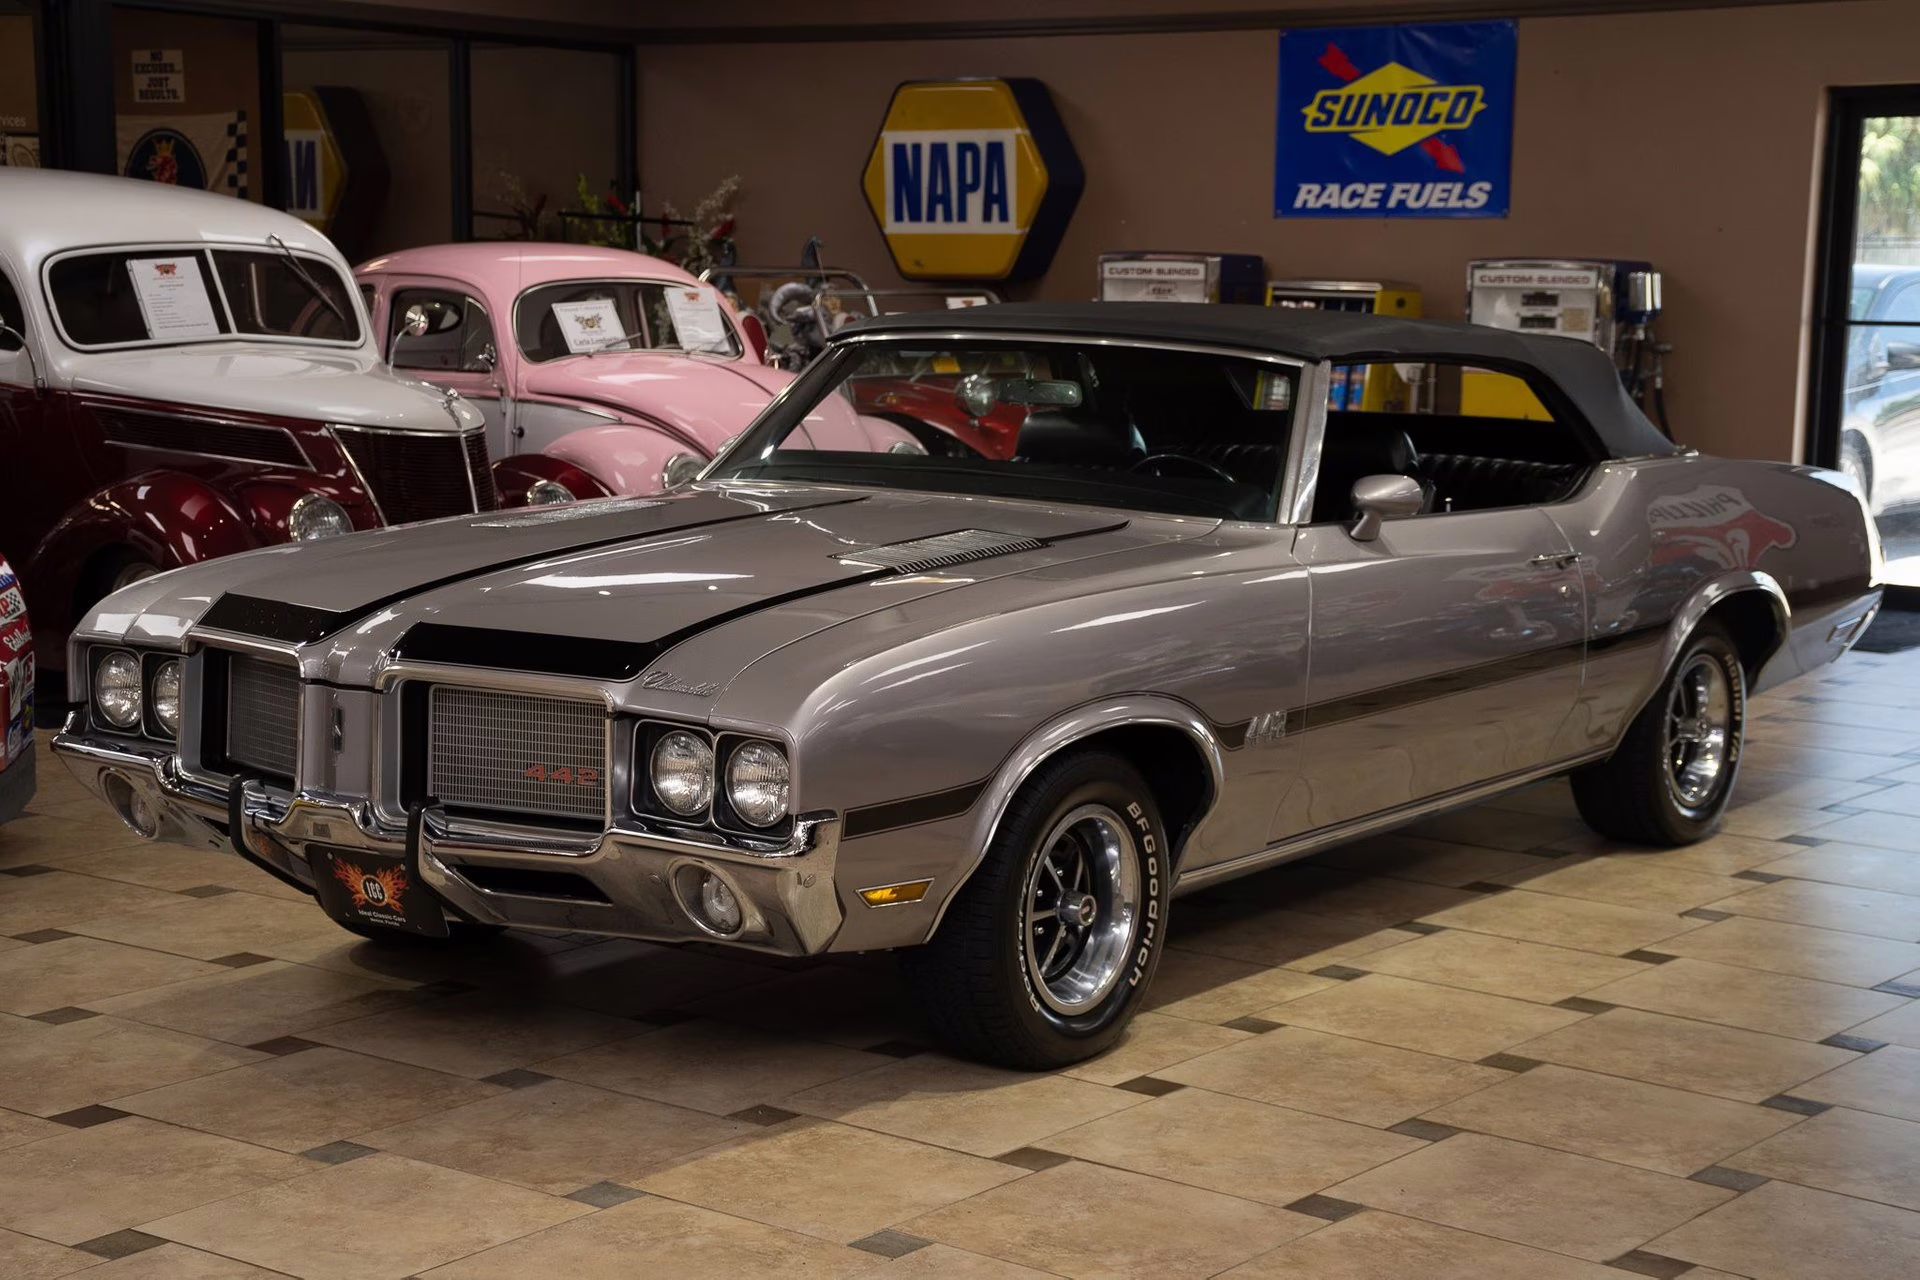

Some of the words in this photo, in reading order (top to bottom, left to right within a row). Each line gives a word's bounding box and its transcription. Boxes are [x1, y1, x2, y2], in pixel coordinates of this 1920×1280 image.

[151, 51, 162, 61] NO
[147, 77, 169, 88] JUST
[1311, 91, 1478, 127] SUNOCO
[893, 141, 1009, 223] NAPA
[1293, 183, 1386, 209] RACE
[1386, 181, 1493, 209] FUELS
[524, 764, 599, 786] 442
[366, 881, 382, 900] ICC
[1127, 802, 1158, 987] BFGoodrich
